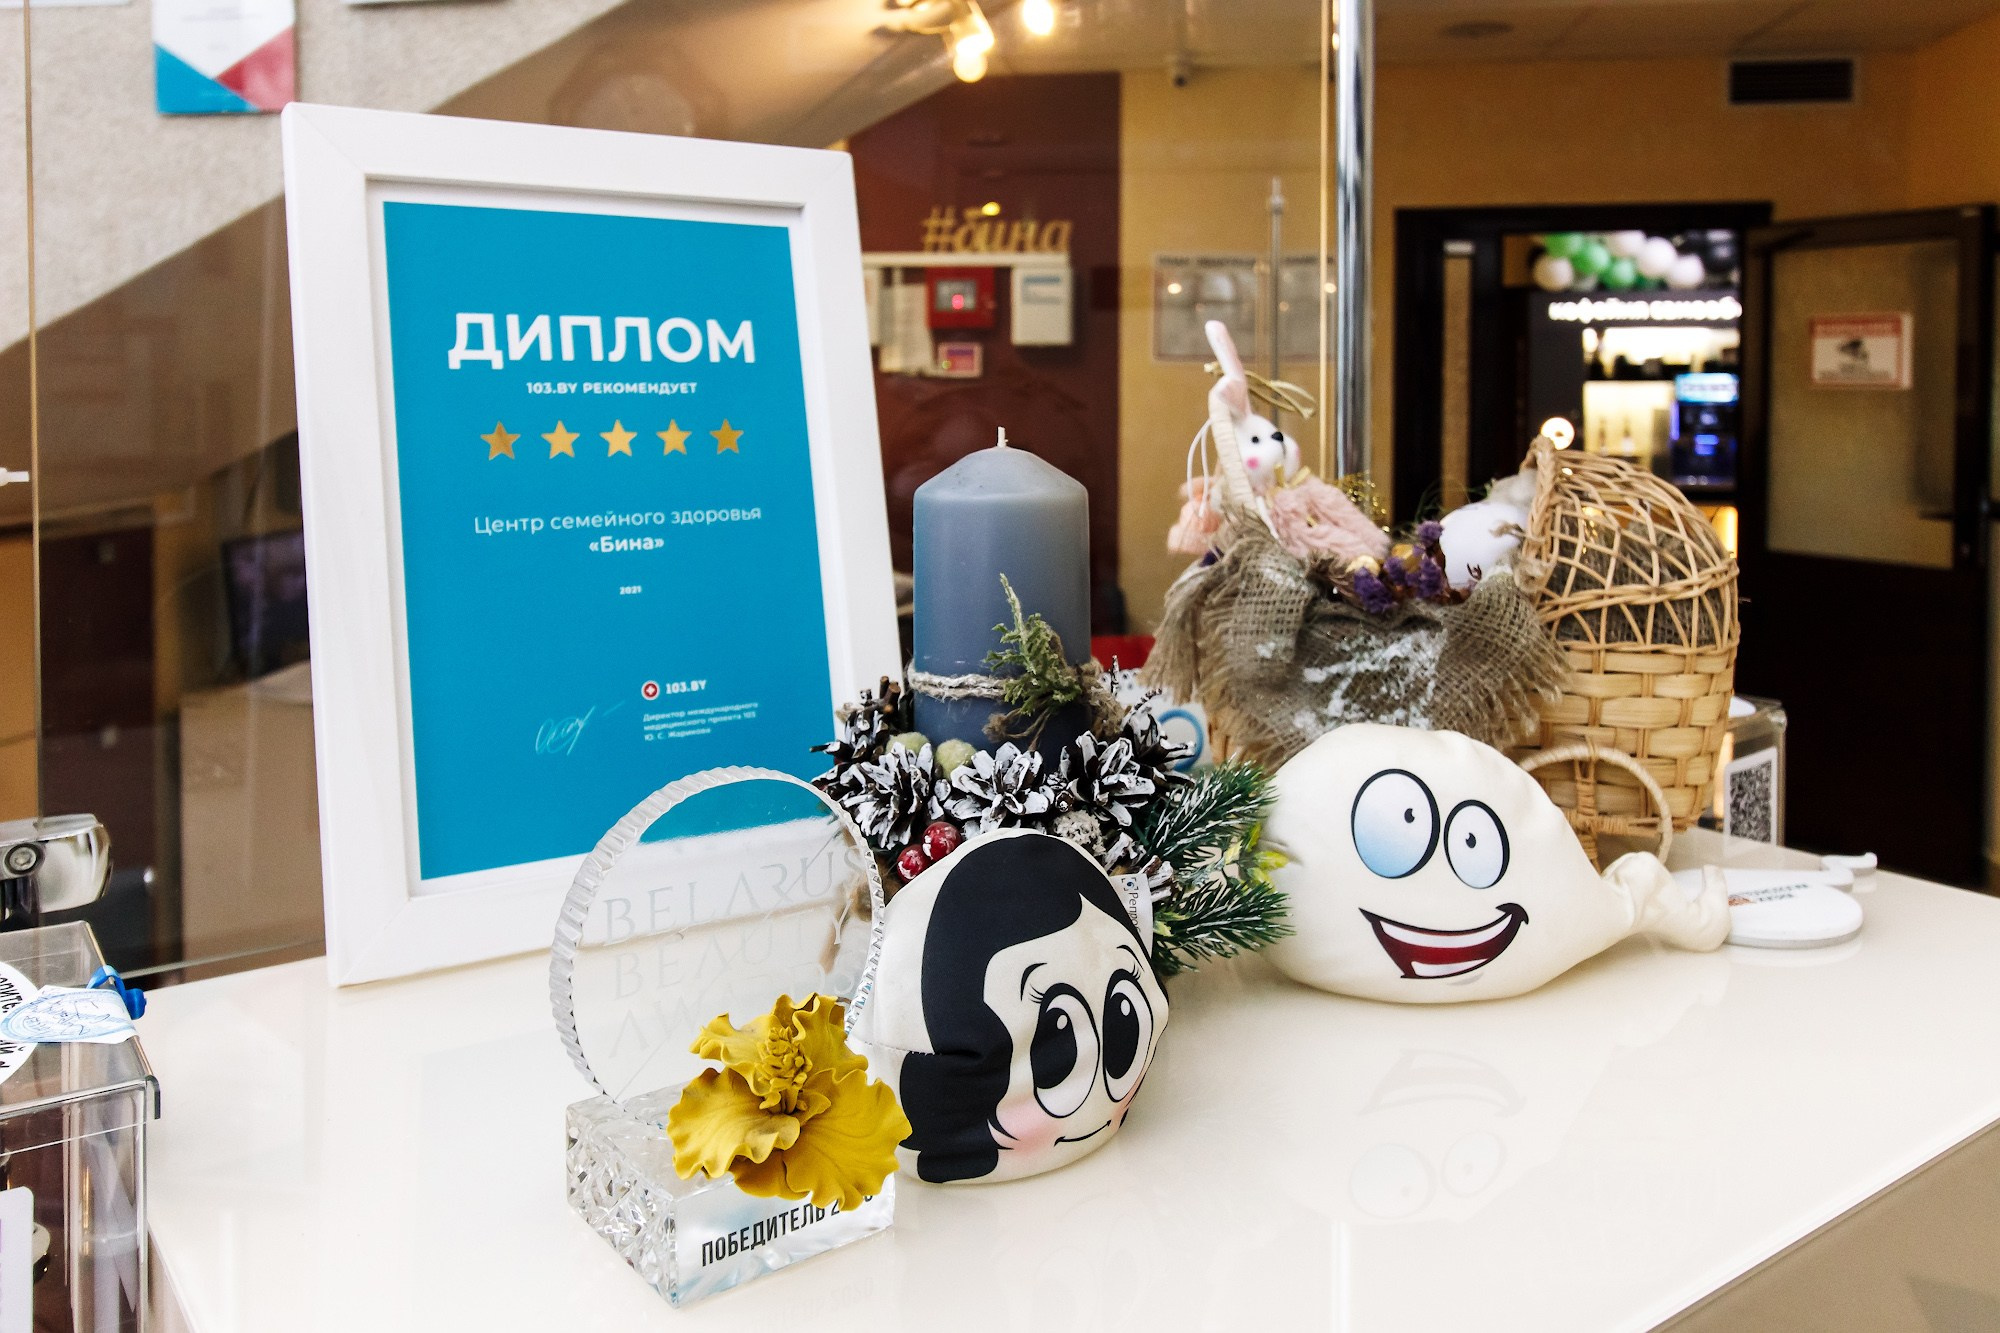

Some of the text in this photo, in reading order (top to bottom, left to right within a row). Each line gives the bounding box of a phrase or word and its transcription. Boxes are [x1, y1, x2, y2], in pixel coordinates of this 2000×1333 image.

[448, 312, 756, 370] ДИПЛОМ
[526, 382, 697, 395] 103.BY РЕКОМЕНДУЕТ
[474, 507, 762, 536] Центр семейного здоровья
[589, 535, 664, 553] «Бина»
[619, 585, 642, 595] 2021
[665, 680, 707, 694] 103.BY
[643, 702, 758, 722] Директор международного
[643, 718, 706, 731] медицинского
[708, 714, 742, 724] проекта
[603, 846, 863, 943] BELARUS
[614, 896, 853, 1000] BEAUTY
[702, 1203, 825, 1267] ПОБЕДИТЕЛЬ
